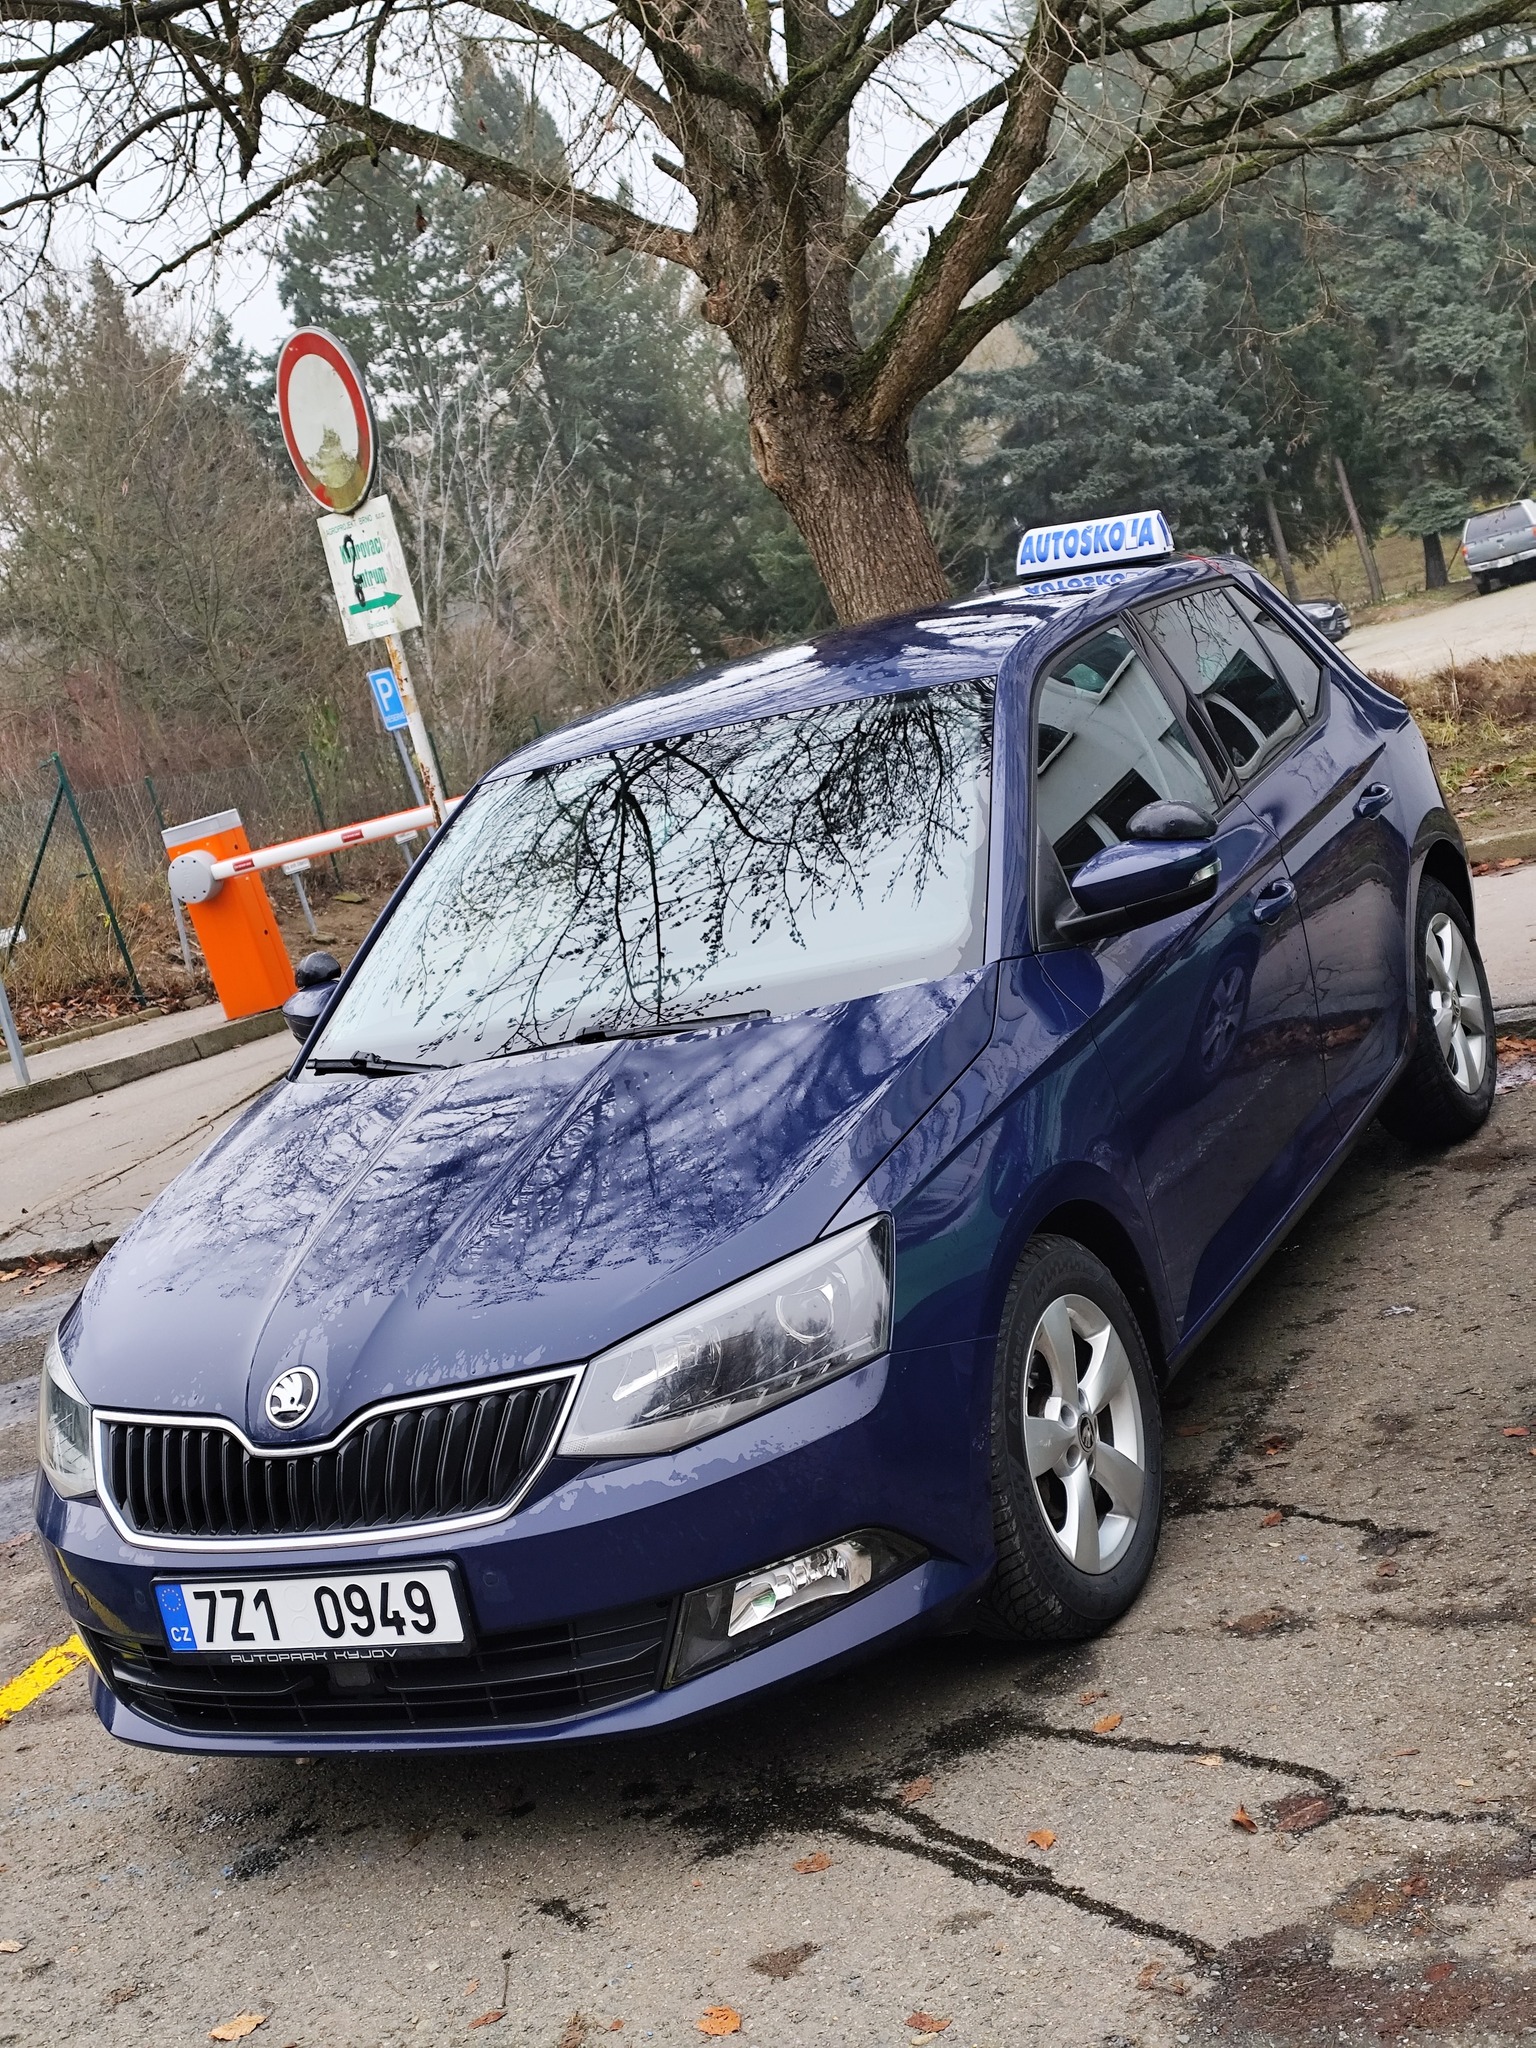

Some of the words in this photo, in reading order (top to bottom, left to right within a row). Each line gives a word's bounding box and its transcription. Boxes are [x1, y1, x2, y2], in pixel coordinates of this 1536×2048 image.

[358, 514, 373, 525] BRNO
[375, 678, 393, 712] P
[193, 1588, 280, 1643] 7Z1
[314, 1580, 436, 1639] 0949
[170, 1626, 192, 1643] CZ
[230, 1651, 328, 1663] AUTOPARK
[334, 1648, 398, 1660] KYJOV
